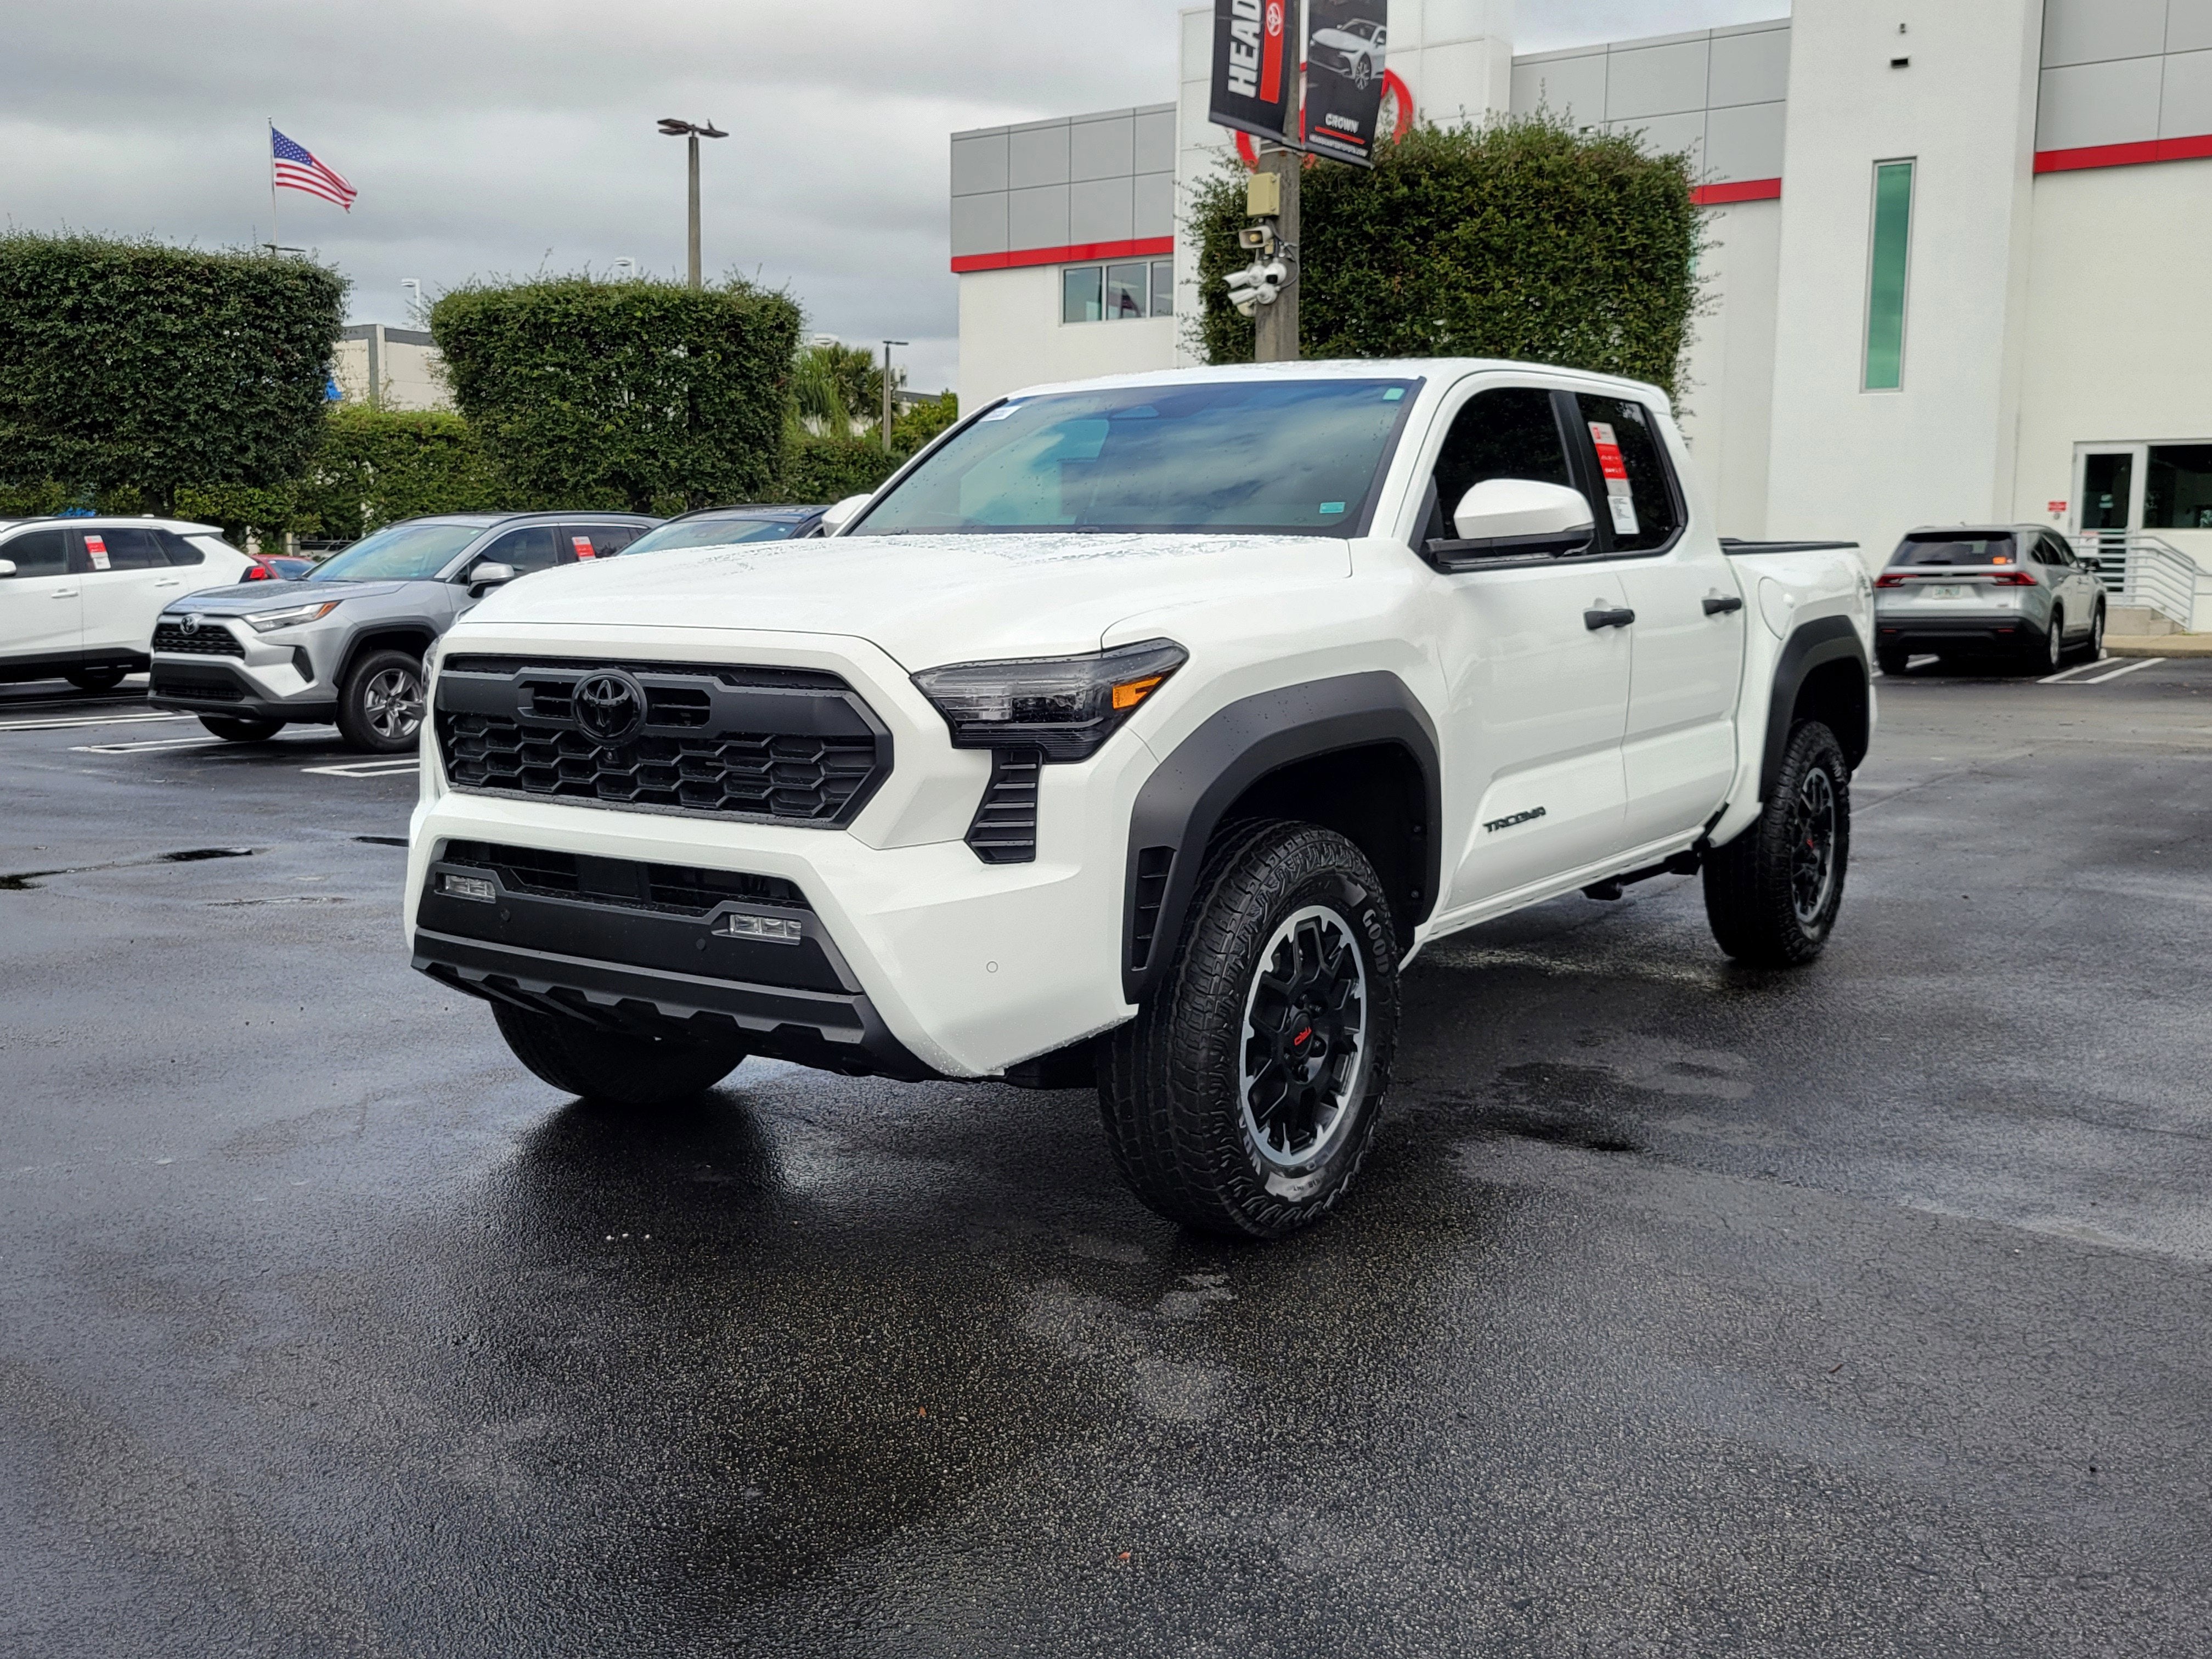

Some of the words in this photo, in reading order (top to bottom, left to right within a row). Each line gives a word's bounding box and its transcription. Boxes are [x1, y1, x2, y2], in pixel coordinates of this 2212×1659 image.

[1228, 0, 1261, 98] HEAD
[1325, 113, 1359, 134] CROWN
[1482, 806, 1546, 832] TACOMA
